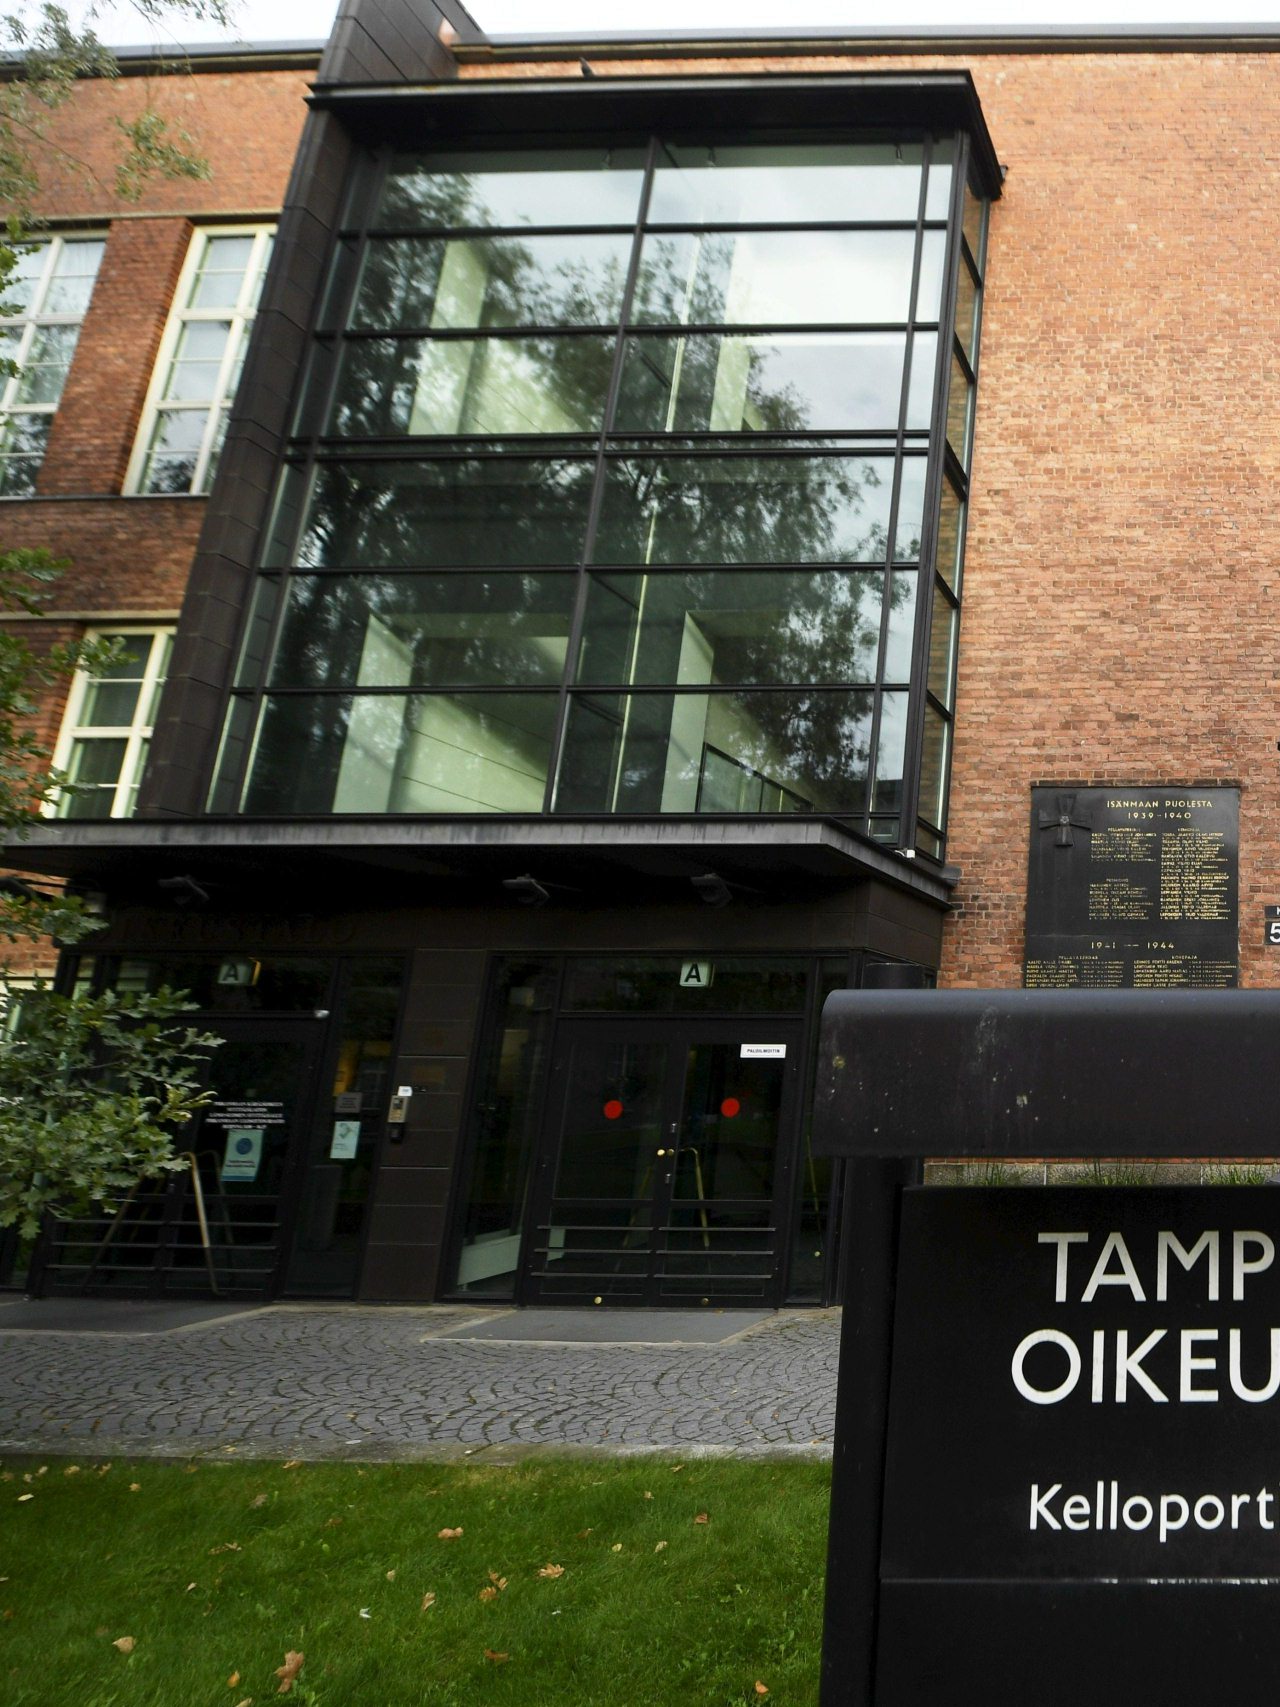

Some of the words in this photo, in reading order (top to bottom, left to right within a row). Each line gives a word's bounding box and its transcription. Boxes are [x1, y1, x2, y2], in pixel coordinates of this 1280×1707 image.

[1107, 800, 1159, 808] ISÄNMAAN
[1165, 800, 1212, 808] PUOLESTA
[1147, 941, 1174, 949] 1944
[222, 963, 239, 981] A
[684, 963, 702, 983] A
